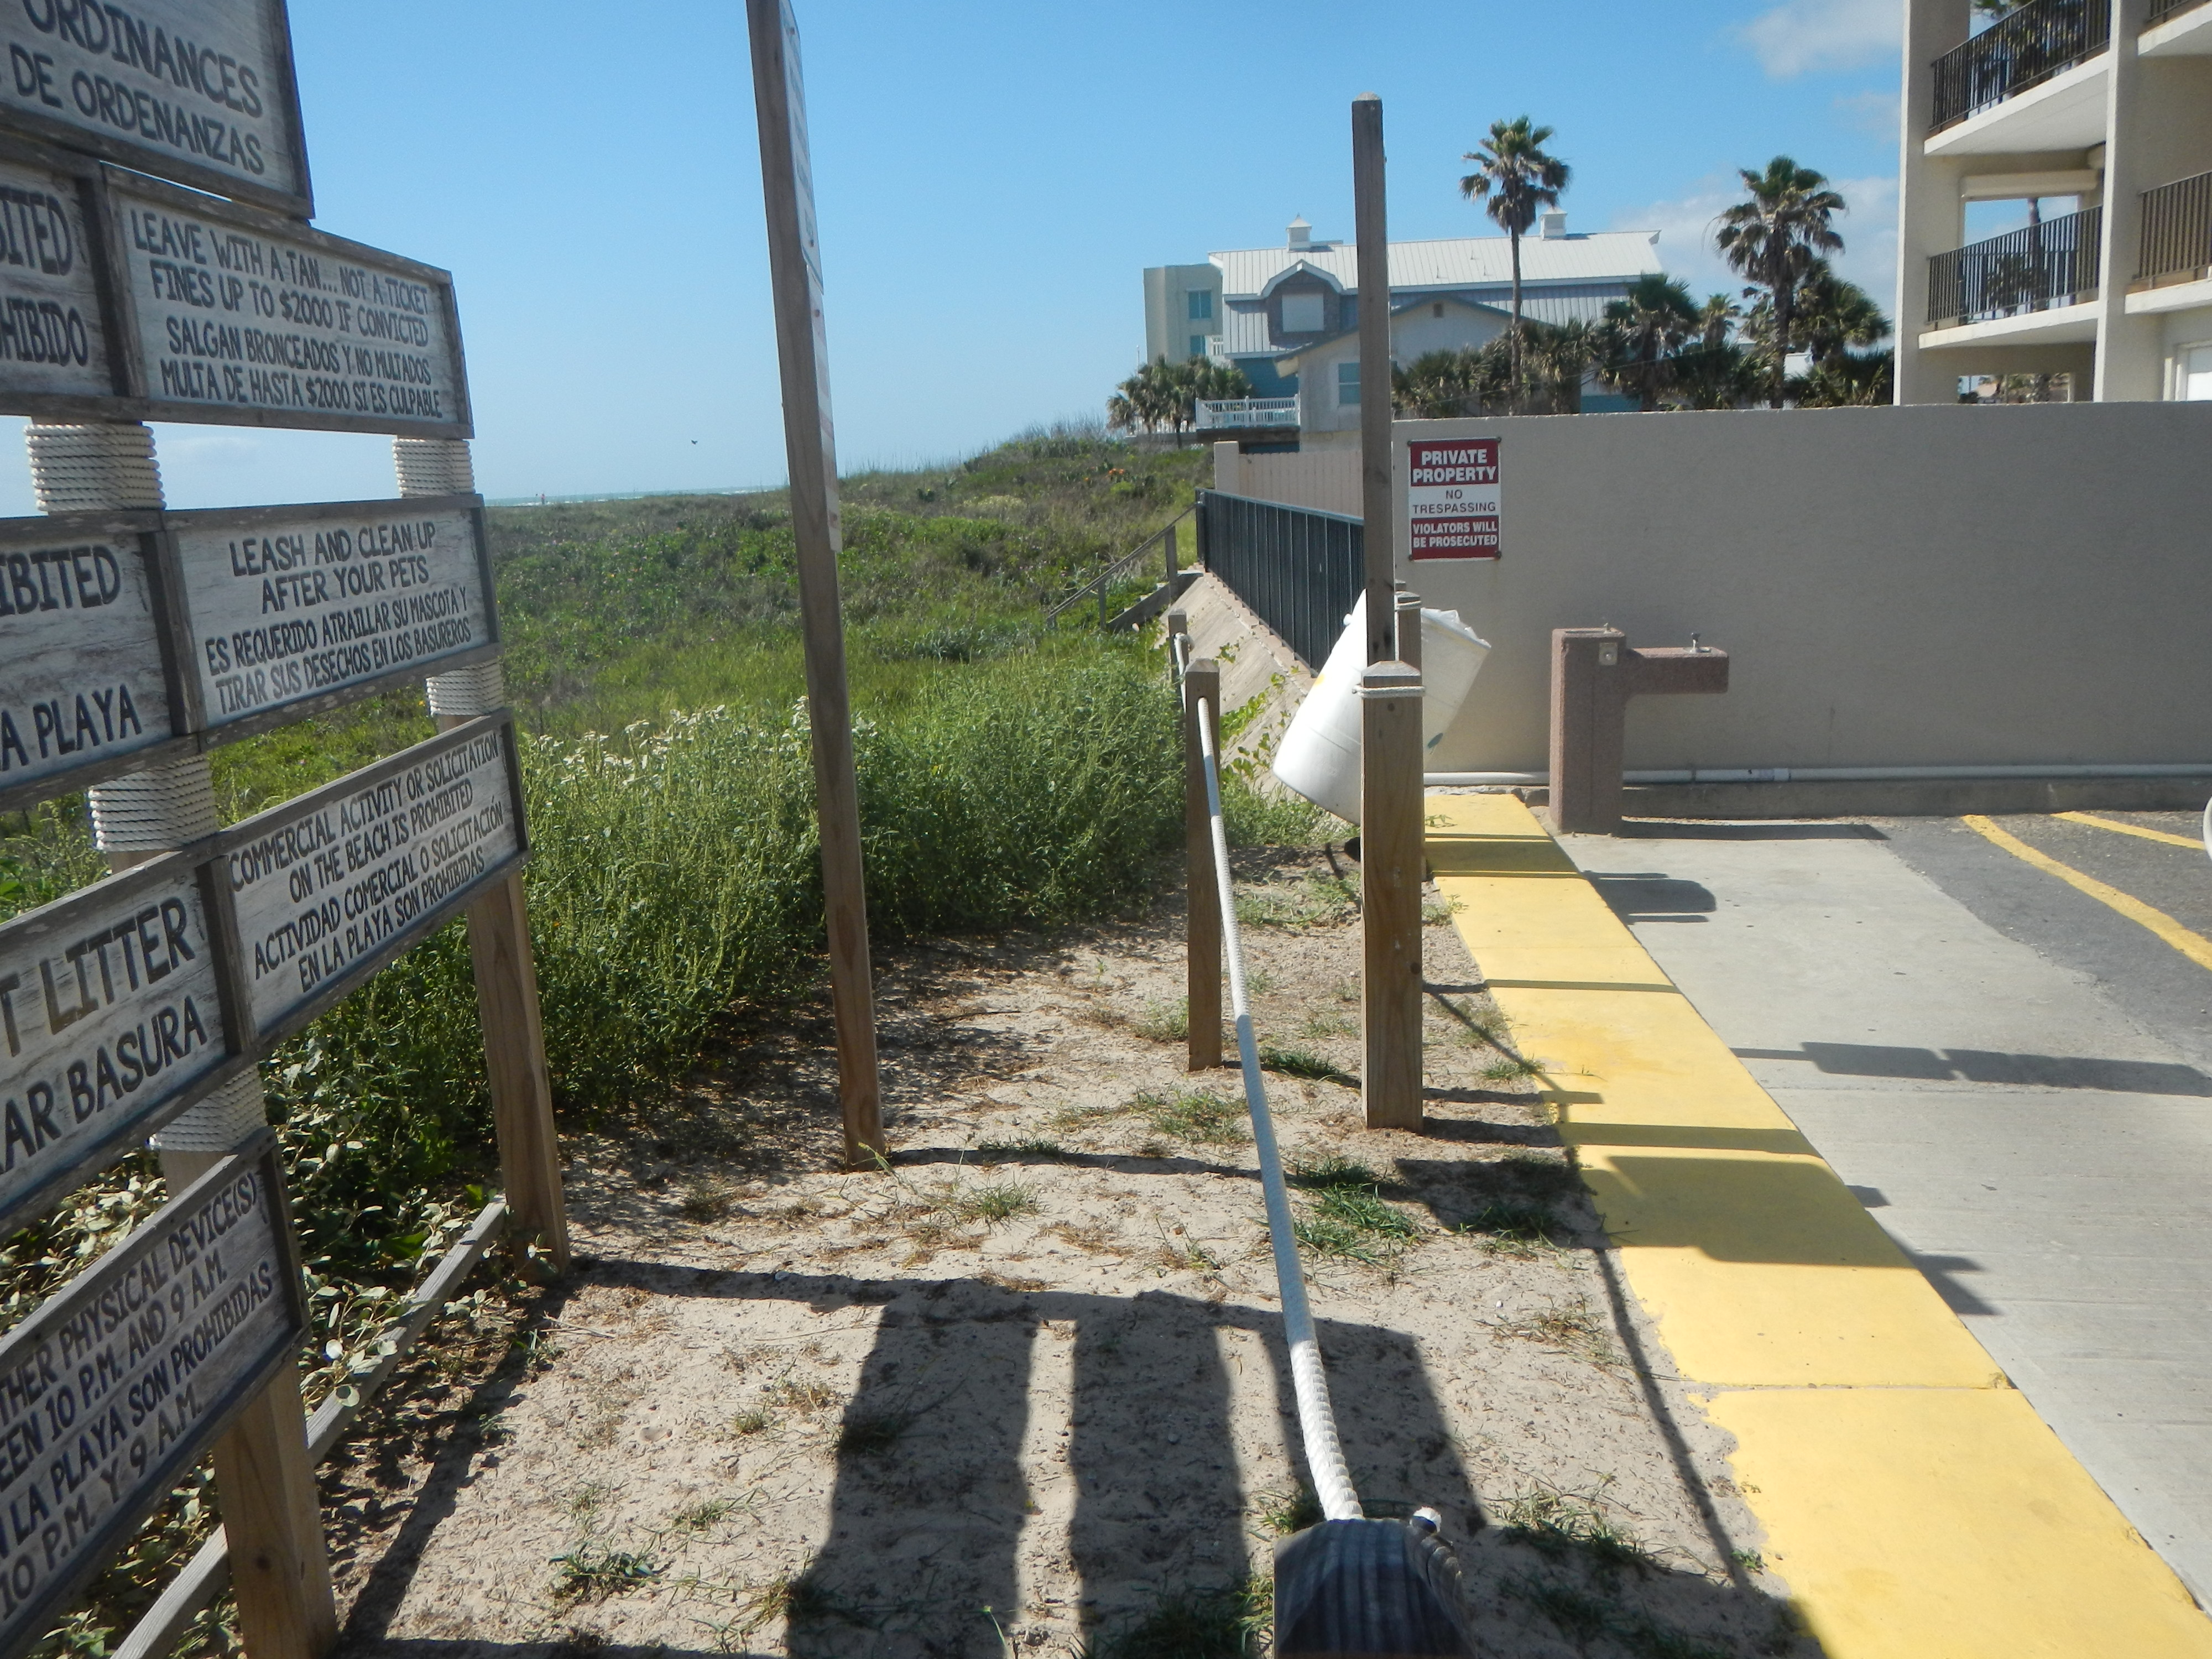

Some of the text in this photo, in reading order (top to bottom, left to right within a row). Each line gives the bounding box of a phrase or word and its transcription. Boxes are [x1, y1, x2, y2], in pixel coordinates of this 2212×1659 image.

[9, 42, 264, 175] DE ORDENANZAS
[0, 184, 72, 276] ITED
[131, 210, 206, 264] LEAVE
[210, 229, 264, 276] WITH
[270, 247, 284, 281] A
[340, 265, 366, 300] NOT
[373, 274, 384, 305] A
[385, 277, 428, 315] TICKET
[149, 259, 429, 347] FINES UP TO $2000 IF CONVICTED
[160, 358, 442, 418] MULTA DE HASTA $2000 SI ES CULPABLE
[166, 315, 431, 385] SALGAN BRONCEADOS Y NO MULTADOS
[1413, 466, 1496, 483] PROPERTY
[1421, 449, 1487, 465] PRIVATE
[1446, 489, 1463, 499] NO
[229, 521, 436, 577] LEASH AND CLEAN UP
[1413, 502, 1496, 514] TRESPASSING
[1413, 521, 1497, 534] VIOLATORS WILL
[1413, 535, 1497, 547] BE PROSECUTED
[205, 585, 467, 676] ES REQUERIDO ATRAILLAR SU MASCOTA Y
[262, 555, 429, 614] AFTER YOUR PETS
[216, 617, 471, 714] TIRAR SUS DESECHOS EN LOS BASUREROS
[33, 683, 142, 759] PLAYA
[230, 732, 498, 892] COMMERCIAL ACTIVITY OR SOLICITATION
[290, 778, 473, 902] ON THE BEACH IS PROHIBITED
[255, 796, 503, 979] ACTIVIDAD COMERCIAL O SOLICITACIÓN
[298, 847, 485, 993] EN LA PLAYA SON PROHIBIDAS
[39, 896, 196, 1035] LITTER
[0, 995, 207, 1174] AR BASURA
[59, 1251, 168, 1370] PHYSICAL
[168, 1172, 257, 1275] DEVICE(S)
[45, 1385, 76, 1442] 10
[79, 1342, 123, 1409] P.M.
[128, 1299, 165, 1369] AND
[170, 1282, 185, 1323] 9
[191, 1247, 227, 1309] A.M.
[9, 1483, 49, 1546] LA
[50, 1406, 127, 1505] PLAYA
[128, 1359, 170, 1427] SON
[170, 1260, 273, 1384] PROHIBIDAS
[41, 1493, 96, 1571] P.M.
[100, 1457, 119, 1503] Y
[130, 1436, 147, 1478] 9
[158, 1383, 202, 1455] A.M.
